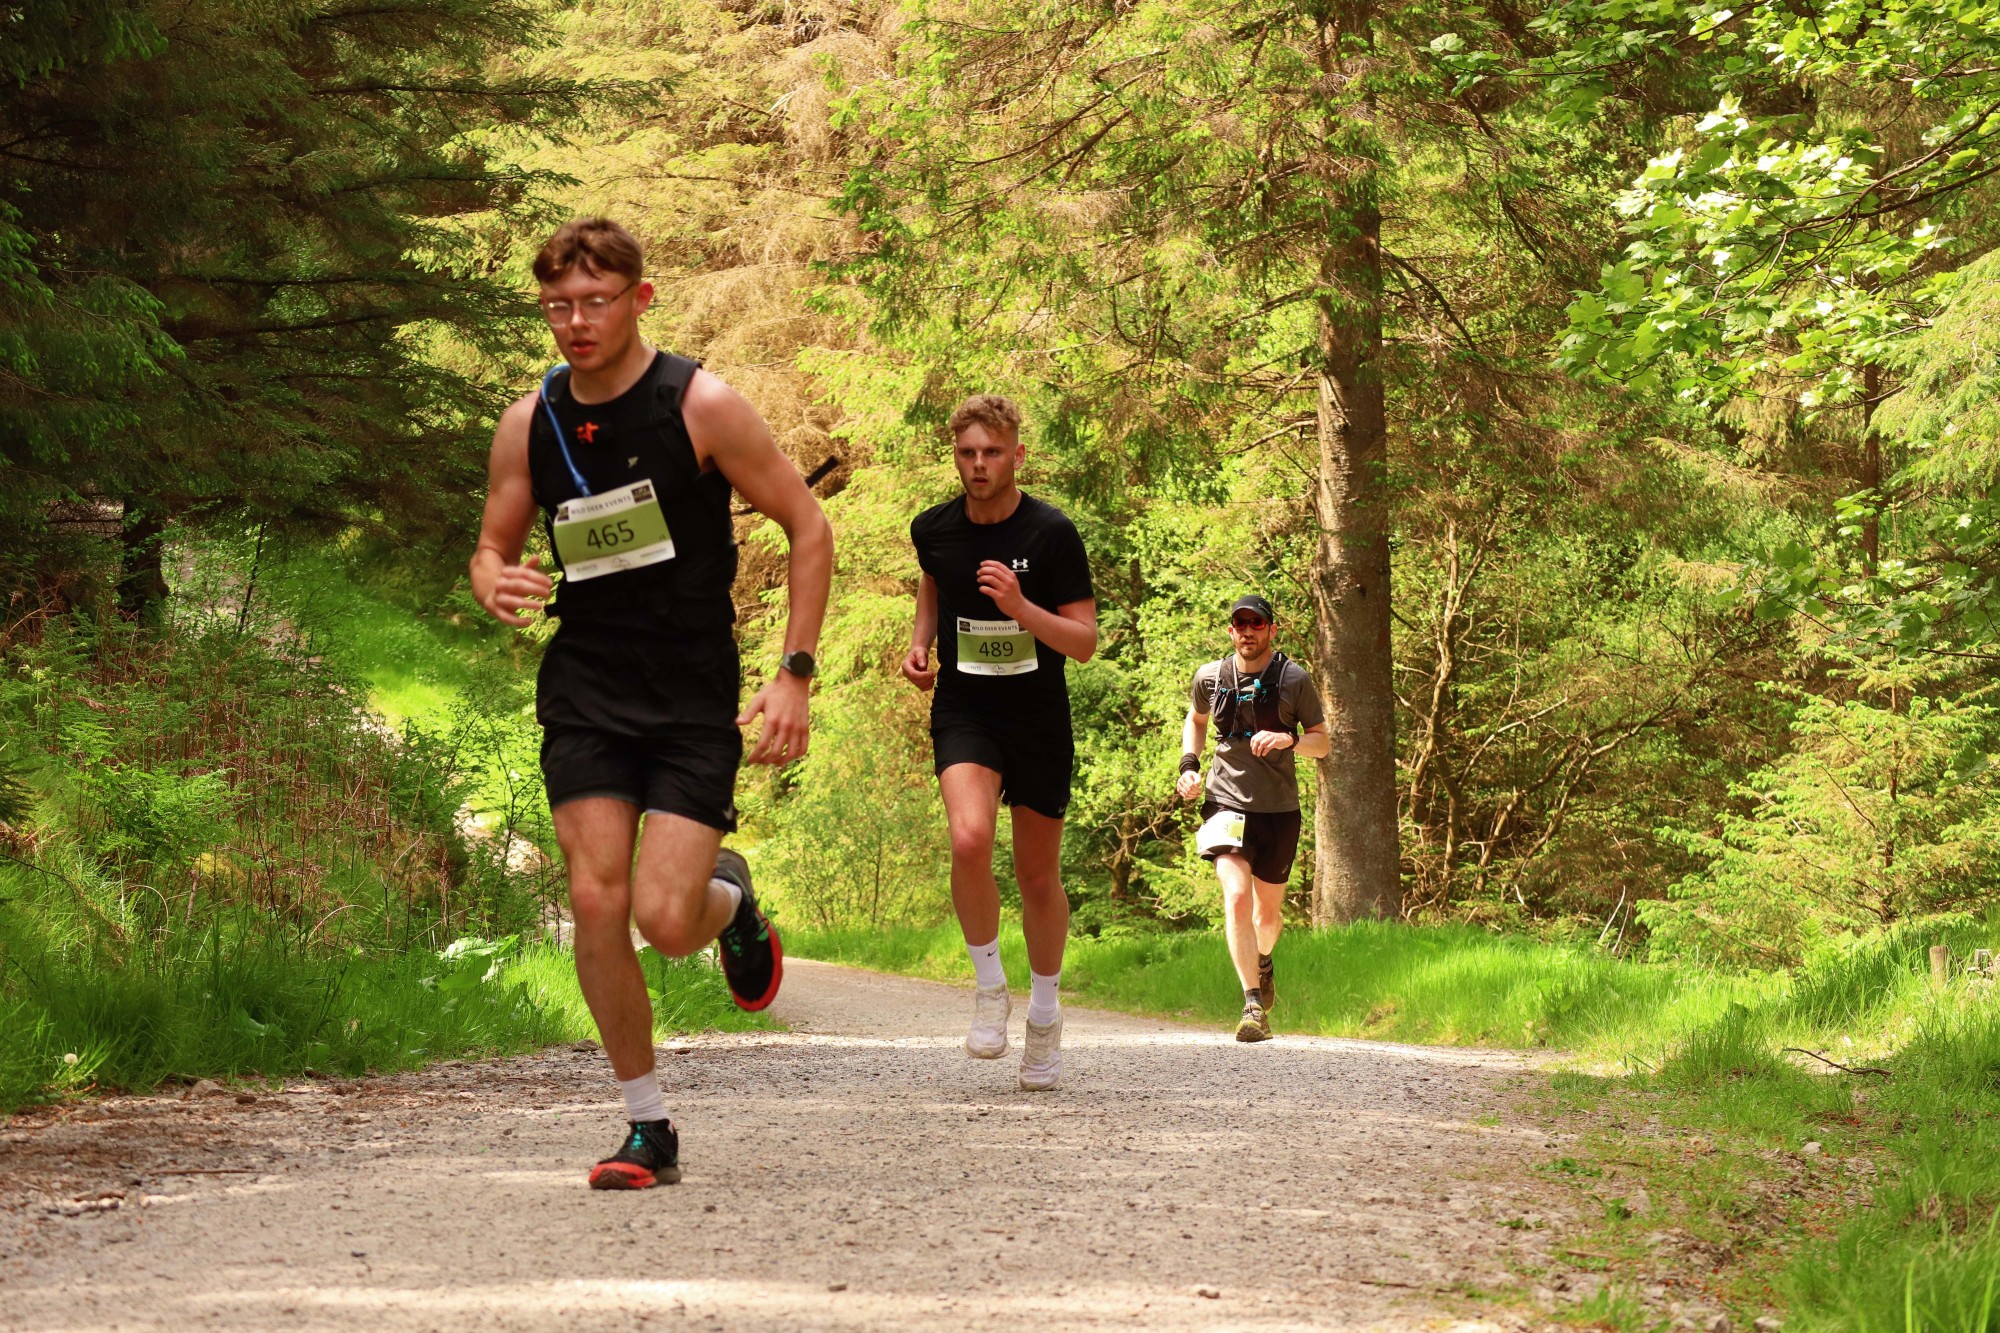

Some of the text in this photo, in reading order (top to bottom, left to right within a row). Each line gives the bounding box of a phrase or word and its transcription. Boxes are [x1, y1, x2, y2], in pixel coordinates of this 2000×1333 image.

[605, 496, 632, 508] EVENTS
[587, 520, 635, 549] 465
[979, 641, 1014, 657] 489
